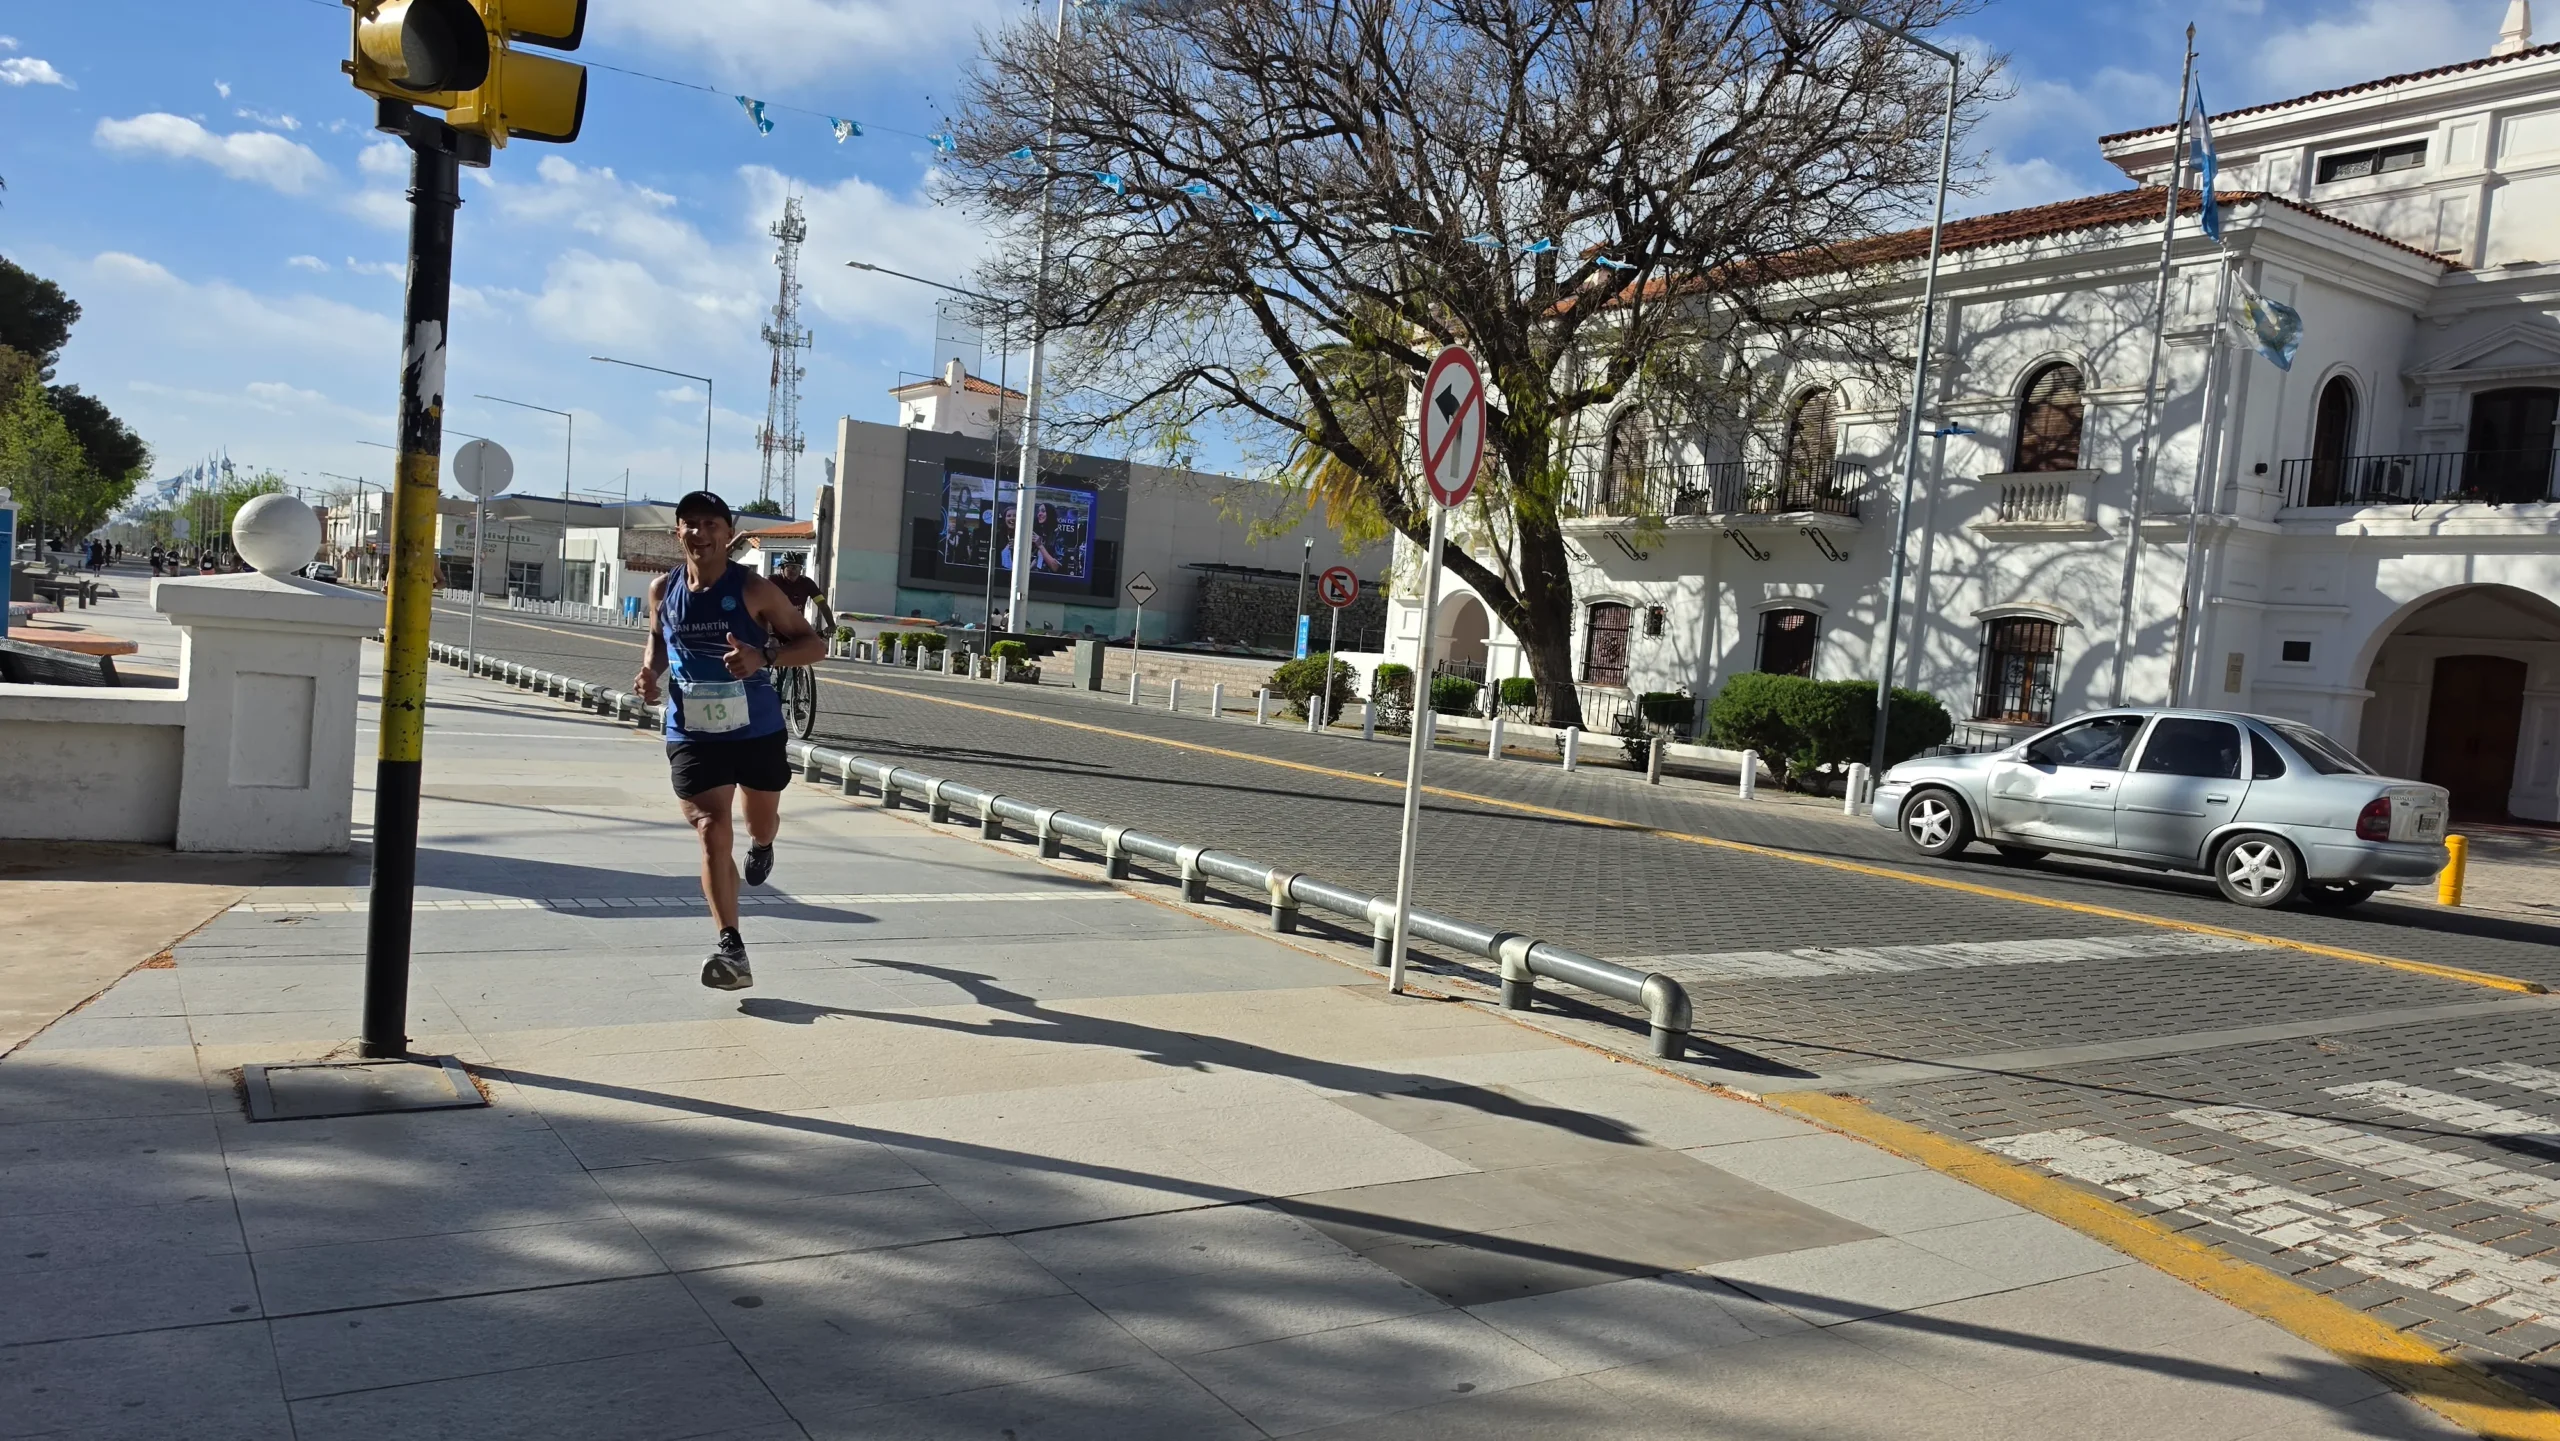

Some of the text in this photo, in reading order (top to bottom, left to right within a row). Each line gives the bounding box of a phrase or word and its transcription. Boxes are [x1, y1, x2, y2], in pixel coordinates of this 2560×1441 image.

[672, 619, 729, 633] SAN MARTÍN
[703, 703, 727, 720] 13
